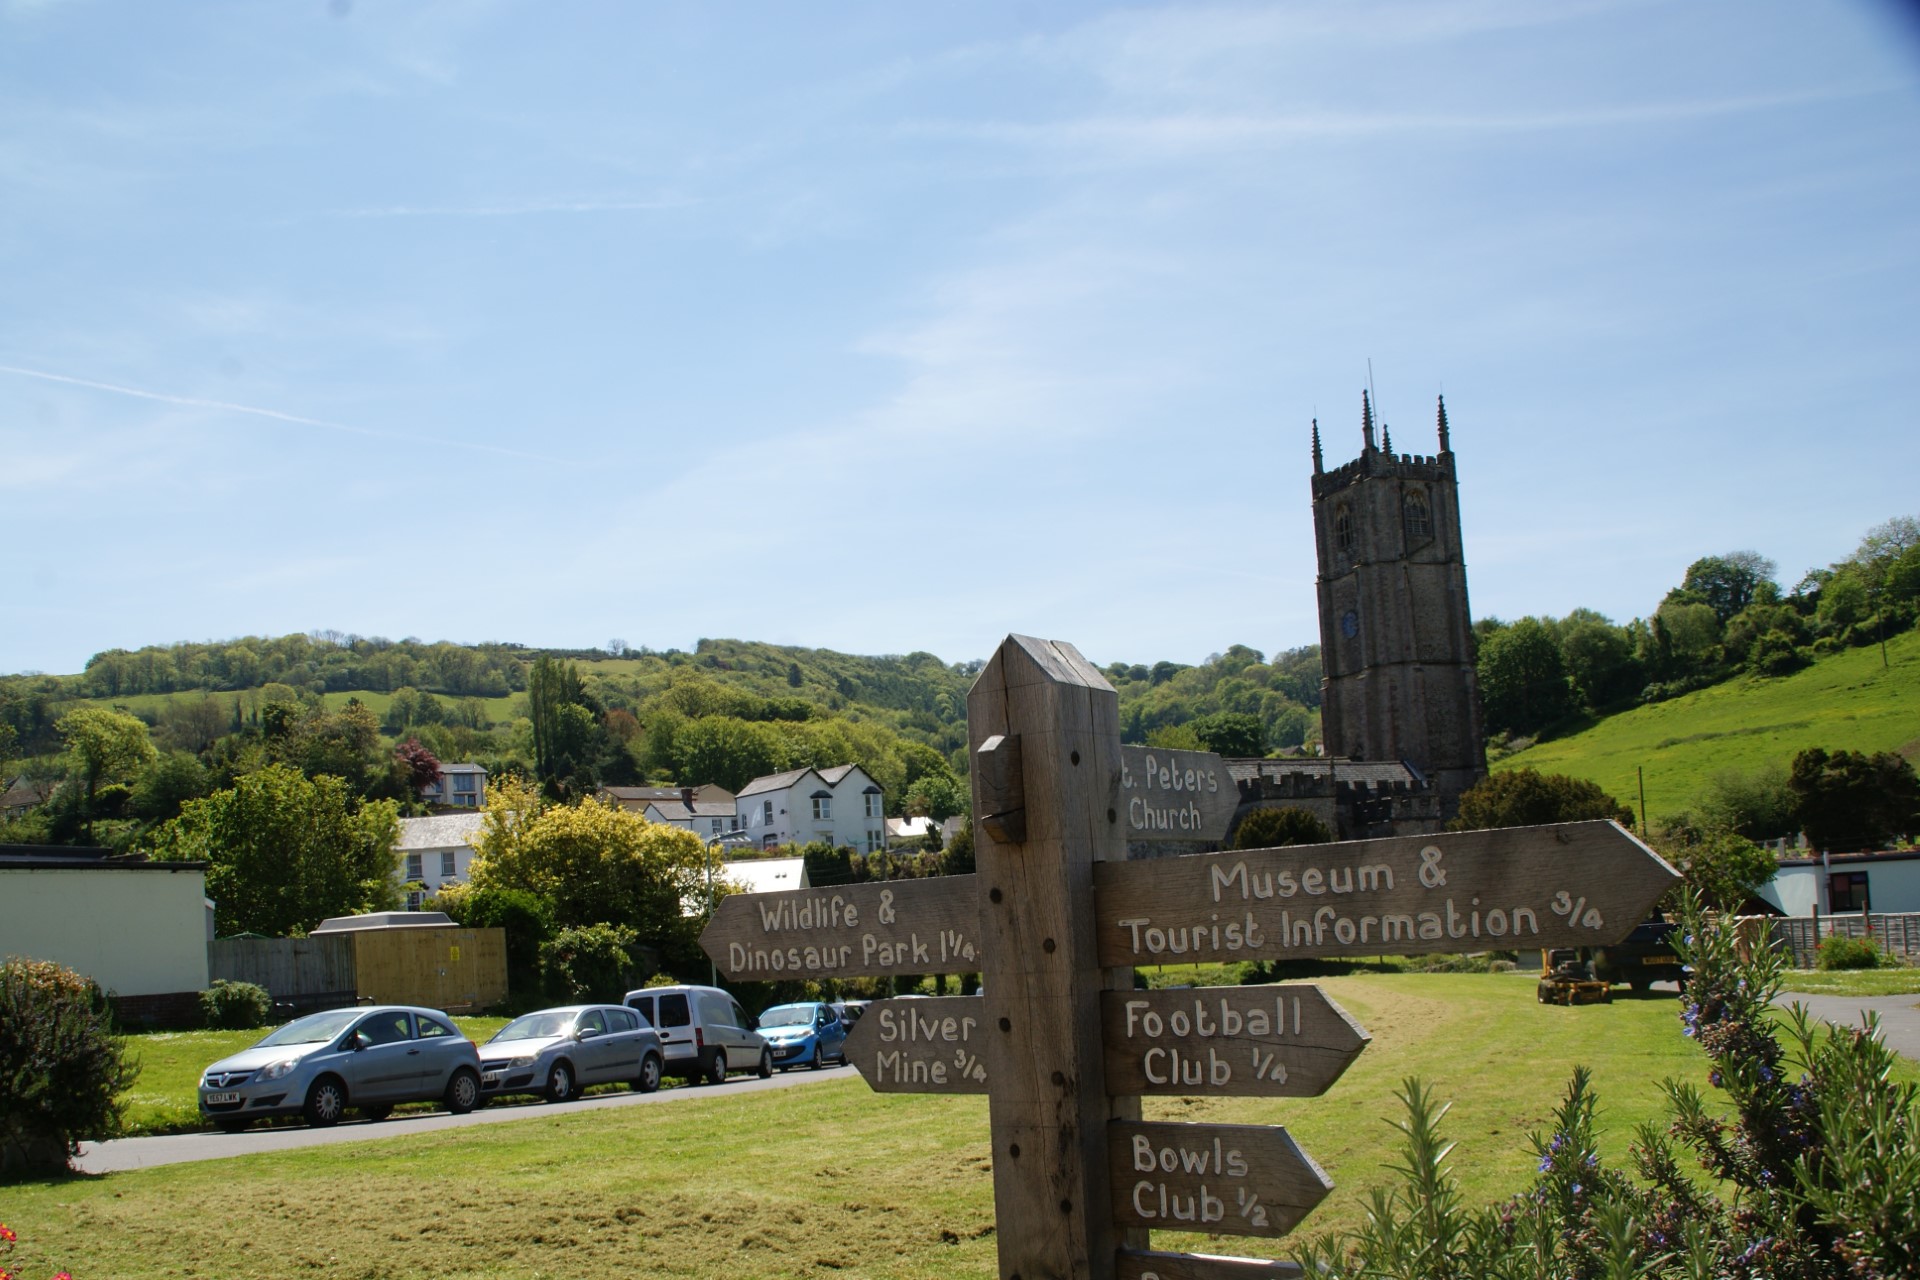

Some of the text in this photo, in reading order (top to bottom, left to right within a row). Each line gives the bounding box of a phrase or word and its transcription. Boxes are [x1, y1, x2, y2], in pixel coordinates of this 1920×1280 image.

[1121, 754, 1218, 793] t. Peters
[1129, 796, 1202, 830] Church
[1211, 845, 1447, 902] Museum &
[758, 889, 896, 932] Wildlife &
[1118, 911, 1265, 955] Tourist
[1281, 897, 1539, 948] Information
[729, 942, 852, 973] Dinosaur
[862, 933, 930, 967] Park
[879, 1007, 977, 1042] Silver
[1125, 996, 1301, 1038] Football
[877, 1050, 948, 1084] Mine
[1144, 1047, 1232, 1087] Club
[1132, 1134, 1249, 1177] Bowls
[1132, 1180, 1225, 1223] Club
